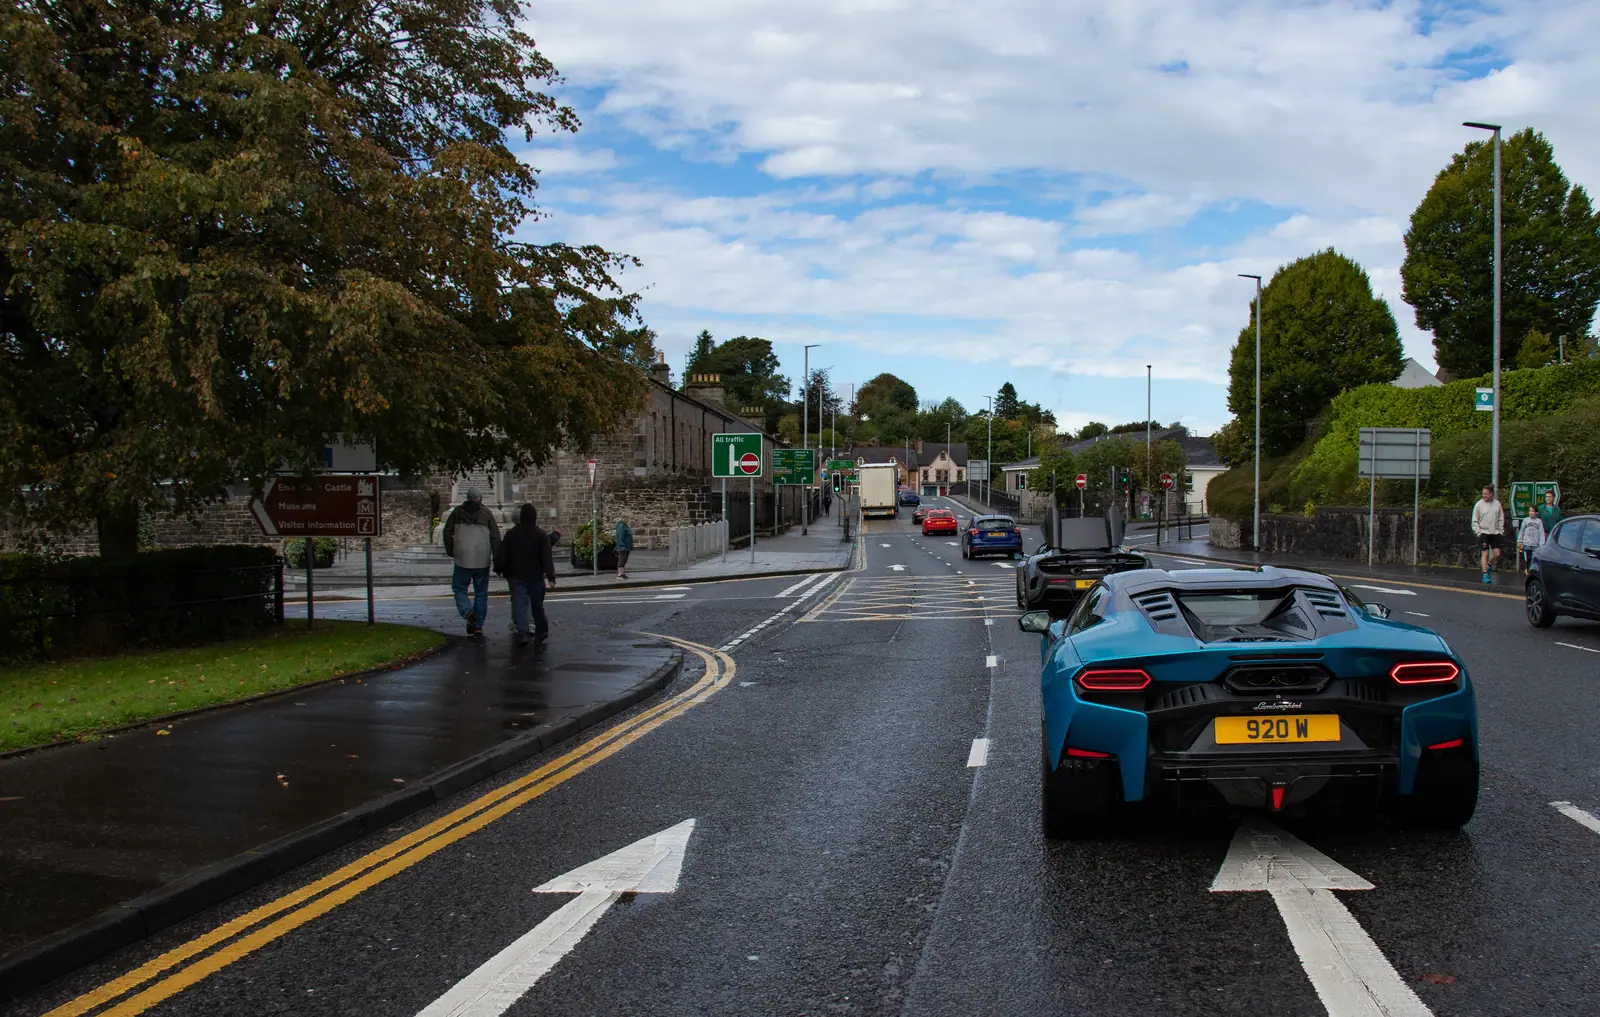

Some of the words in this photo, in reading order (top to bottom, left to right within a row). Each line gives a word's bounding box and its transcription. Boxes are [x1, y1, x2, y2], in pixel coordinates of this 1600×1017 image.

[324, 483, 352, 492] Castle
[278, 520, 305, 529] Visitor
[307, 520, 356, 529] Information
[1253, 701, 1303, 711] Lamborghini
[1247, 718, 1288, 739] 920
[1295, 718, 1308, 738] W
